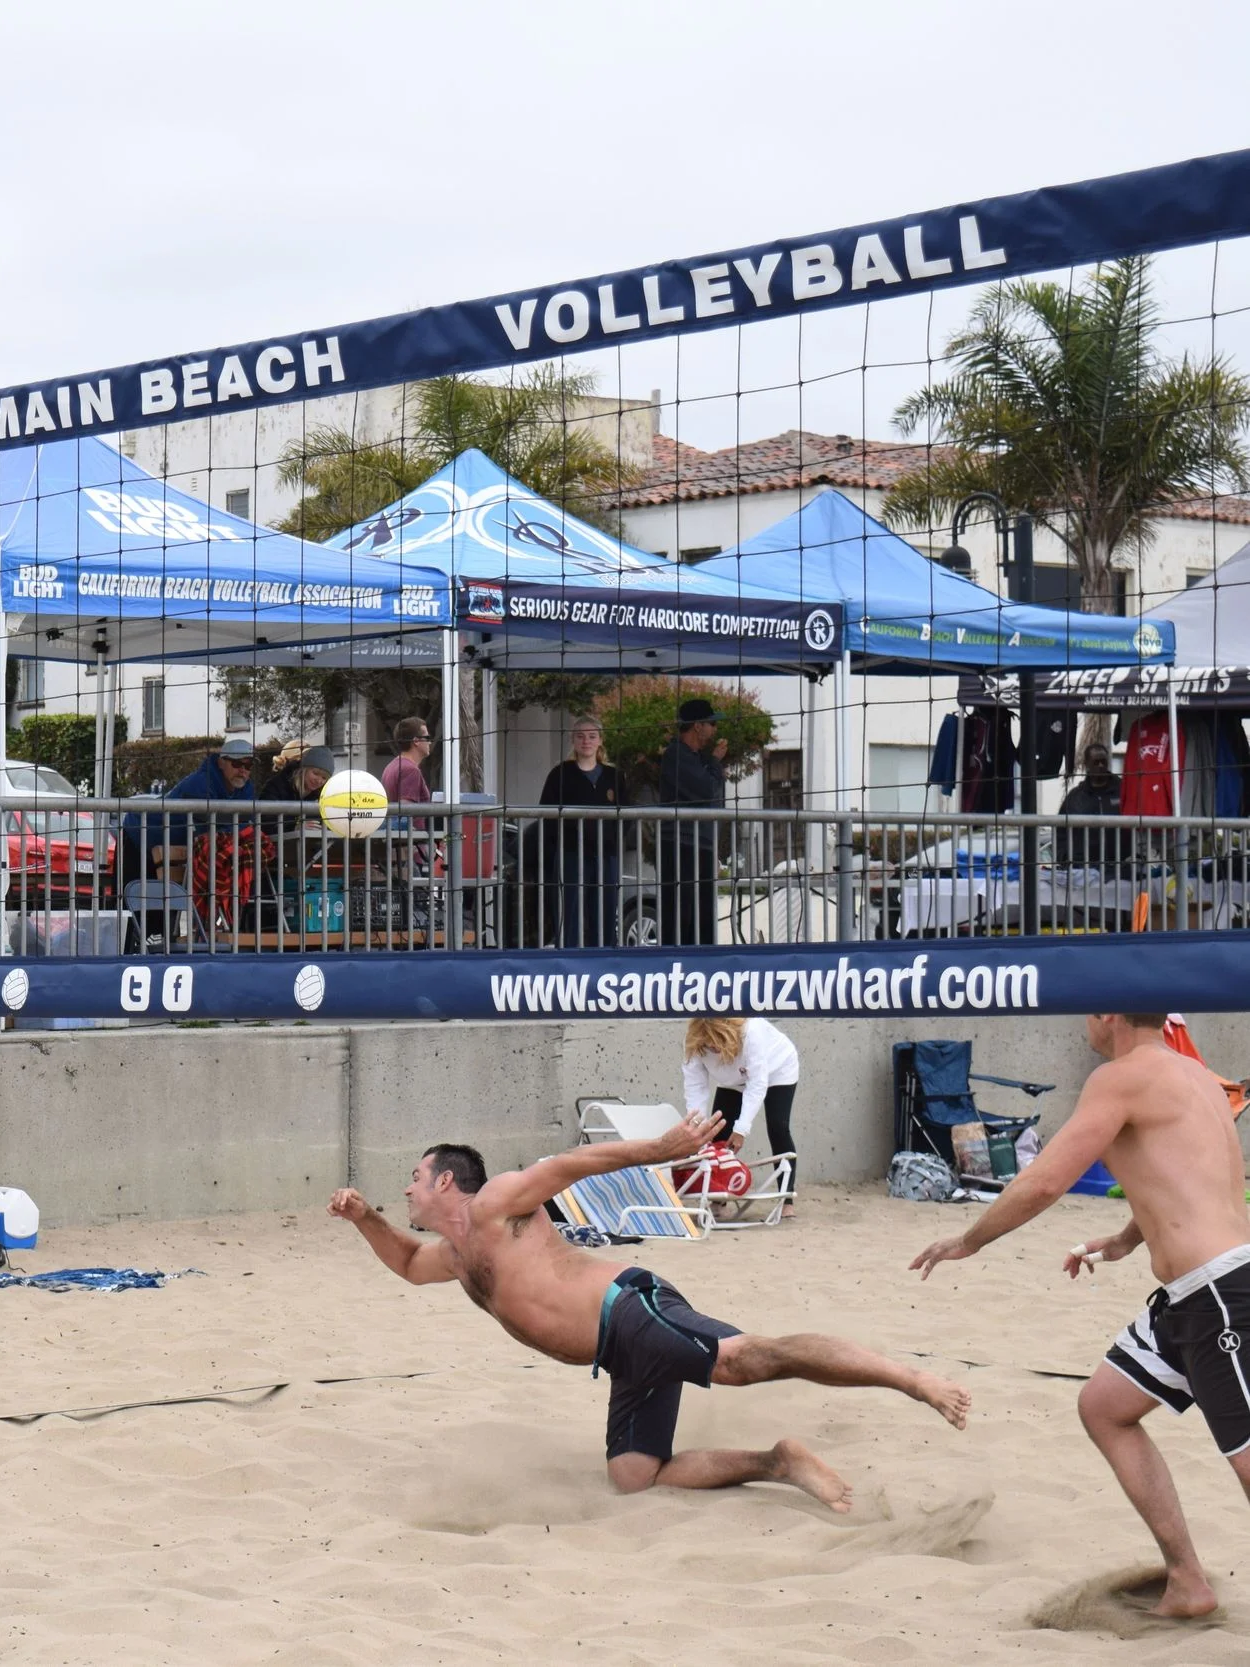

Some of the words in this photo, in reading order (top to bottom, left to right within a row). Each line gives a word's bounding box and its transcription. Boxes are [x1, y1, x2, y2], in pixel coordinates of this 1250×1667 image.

[495, 216, 1006, 350] VOLLEYBALL
[140, 336, 345, 415] BEACH
[82, 488, 198, 522] BUD
[86, 510, 246, 543] LIGHT
[13, 580, 64, 598] LIGHT
[18, 564, 58, 582] BUD
[78, 573, 162, 598] CALIFORNIA
[164, 577, 211, 600] BEACH
[213, 579, 292, 604] VOLLEYBALL
[294, 584, 382, 609] ASSOCIATION
[393, 599, 440, 616] LIGHT
[401, 584, 434, 601] BUD
[510, 597, 569, 621] SERIOUS
[571, 603, 606, 624] GEAR
[608, 604, 634, 626] FOR
[638, 607, 709, 633] HARDCORE
[712, 613, 800, 640] COMPETITION
[490, 955, 1038, 1011] www.santacruzwharf.com
